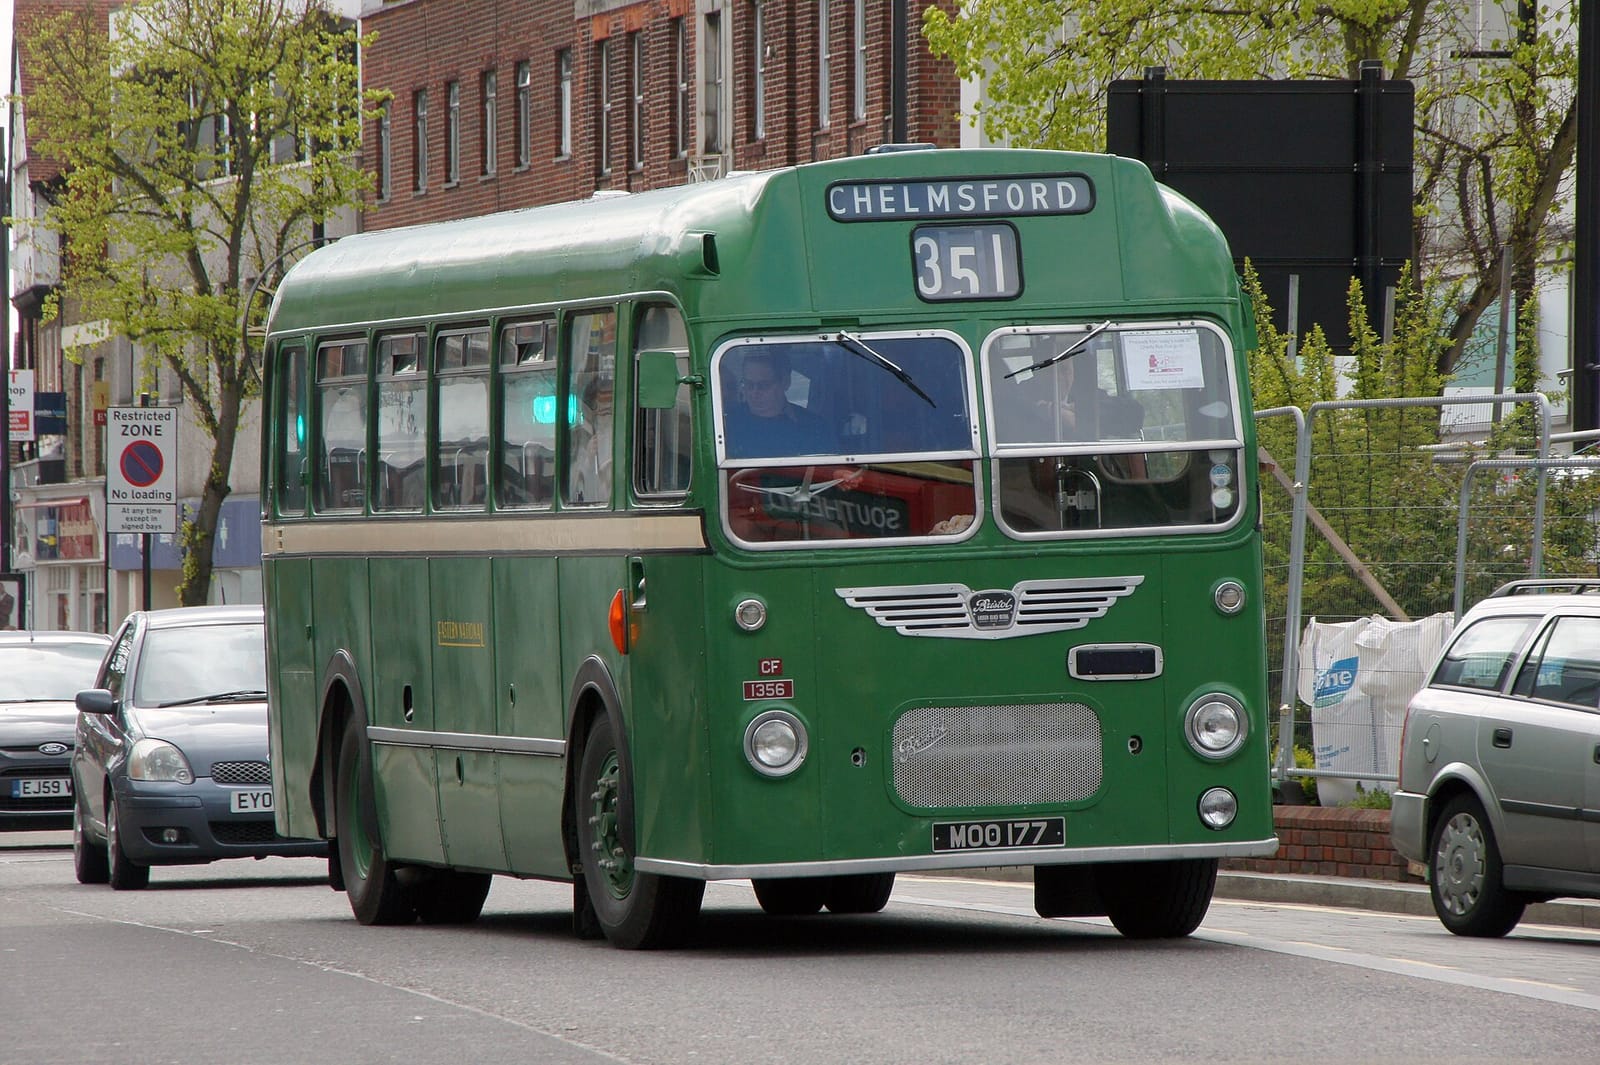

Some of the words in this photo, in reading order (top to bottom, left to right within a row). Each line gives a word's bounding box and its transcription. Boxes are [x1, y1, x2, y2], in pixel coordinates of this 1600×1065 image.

[829, 181, 1077, 215] CHELMSFORD
[914, 233, 1005, 295] 351
[113, 410, 171, 421] Restricted
[121, 424, 162, 437] ZONE
[112, 489, 128, 499] No
[131, 489, 172, 502] loading
[973, 598, 1013, 612] Bristol
[761, 660, 780, 674] CF
[751, 683, 785, 697] 1356
[23, 780, 61, 795] EJ59
[949, 823, 1001, 849] MOO
[1007, 821, 1048, 846] 177
